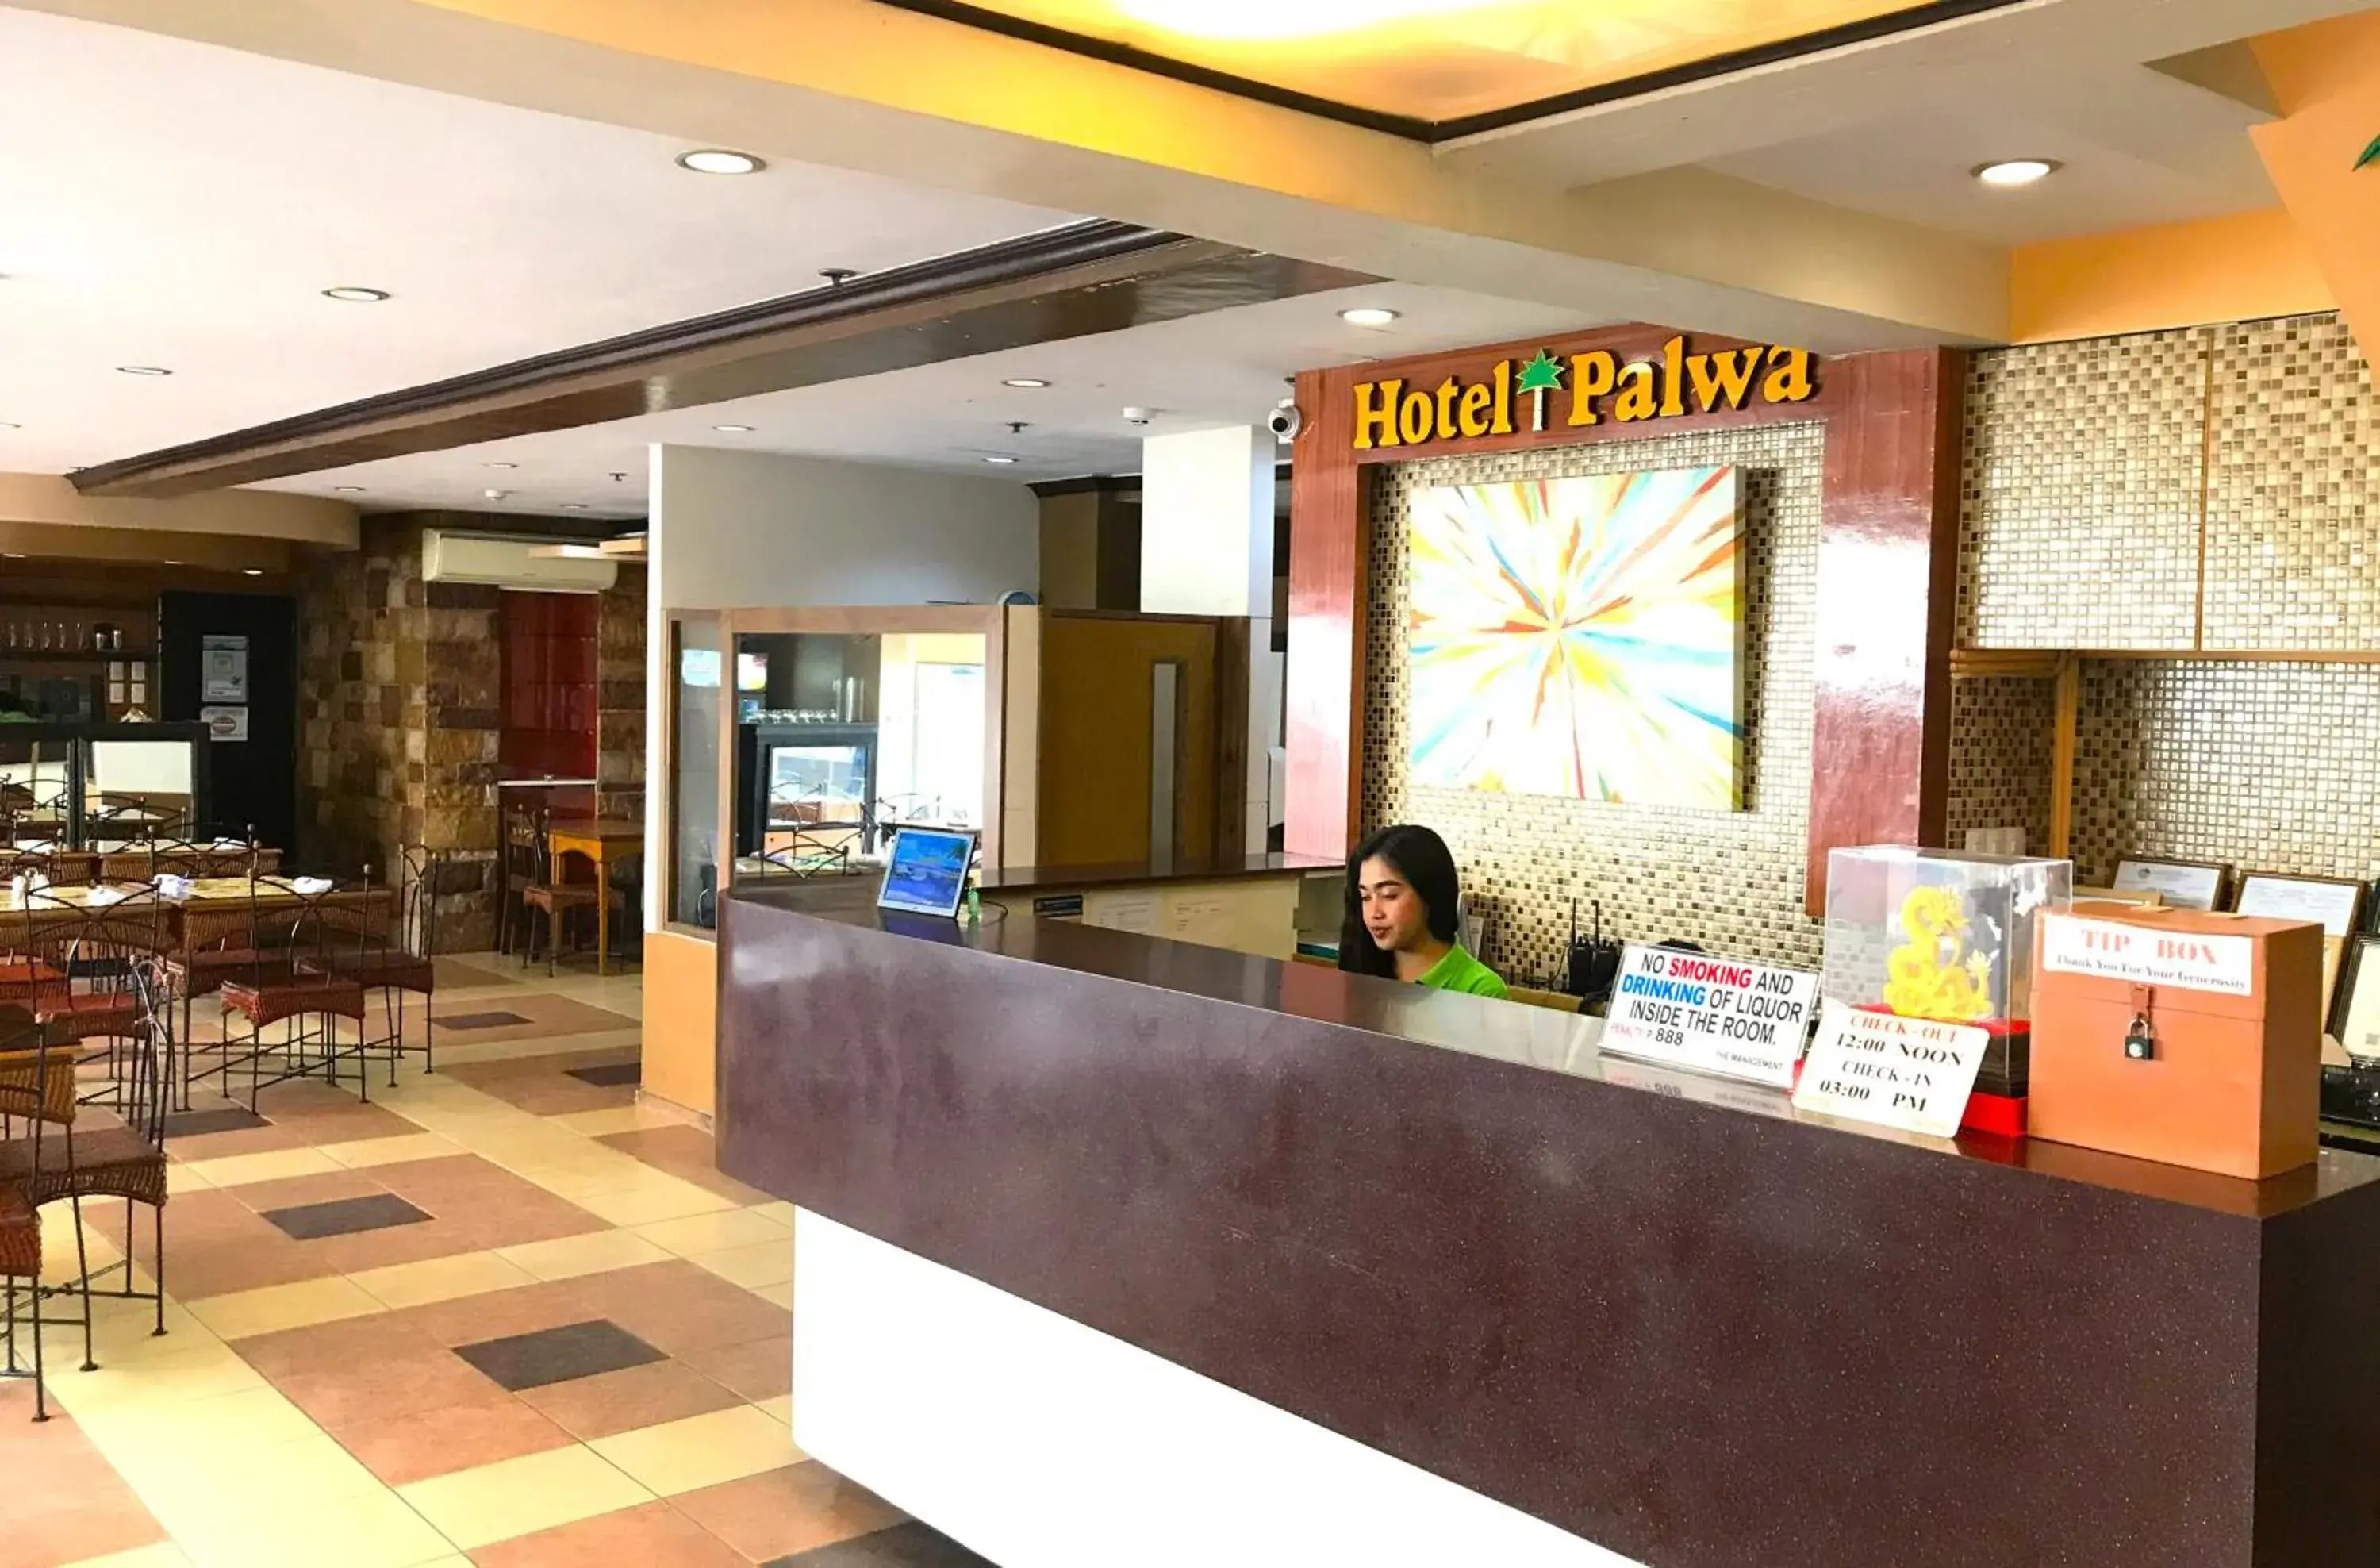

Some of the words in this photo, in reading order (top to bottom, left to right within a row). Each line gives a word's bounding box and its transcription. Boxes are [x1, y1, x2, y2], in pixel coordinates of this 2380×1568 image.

[1353, 359, 1513, 449] Hotel
[1568, 336, 1814, 426] Palwa
[2082, 929, 2131, 951] TIP
[2157, 939, 2216, 964] BOX
[1641, 953, 1665, 973] NO
[1668, 957, 1752, 988] SMOKING
[1755, 971, 1794, 995] AND
[2056, 953, 2092, 969] Thank
[2097, 959, 2117, 971] You
[2121, 963, 2141, 974] For
[2145, 966, 2175, 979] Your
[2178, 970, 2246, 991] Generosity
[1622, 974, 1706, 1005] DRINKING
[1710, 989, 1733, 1010] OF
[1737, 993, 1803, 1024] LIQUOR
[1630, 999, 1683, 1028] INSIDE
[1687, 1009, 1719, 1034] THE
[1721, 1017, 1777, 1046] ROOM.
[1731, 1054, 1783, 1070] MANAGEMENT
[1836, 1033, 1886, 1053] 12:00
[1898, 1042, 1964, 1066] NOON
[1819, 1079, 1871, 1101] 03:00
[1892, 1092, 1927, 1113] PM
